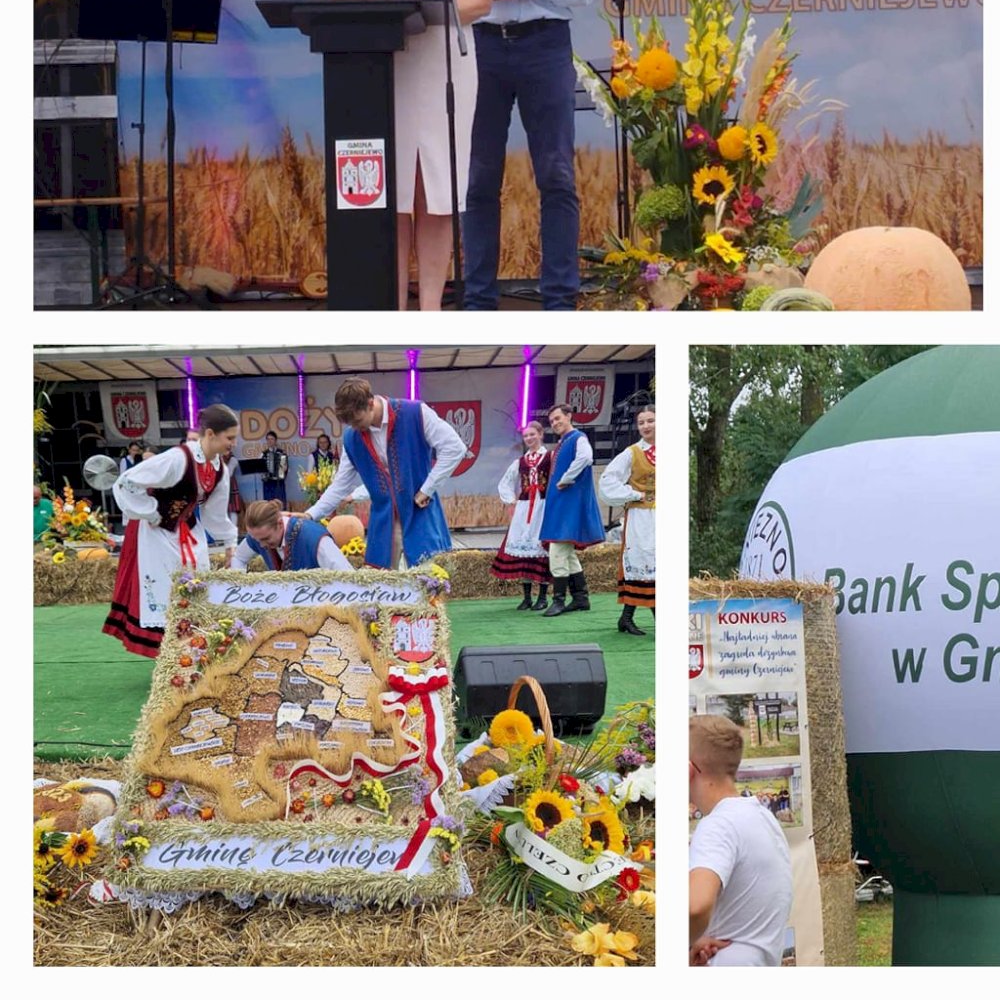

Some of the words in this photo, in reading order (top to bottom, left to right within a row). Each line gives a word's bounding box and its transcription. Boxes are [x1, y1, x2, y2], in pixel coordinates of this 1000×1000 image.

[223, 585, 279, 604] Boże
[292, 584, 412, 606] Błogosław
[824, 562, 927, 615] Bank
[718, 611, 787, 624] KONKURS
[891, 647, 928, 683] w
[158, 842, 254, 867] Gminę
